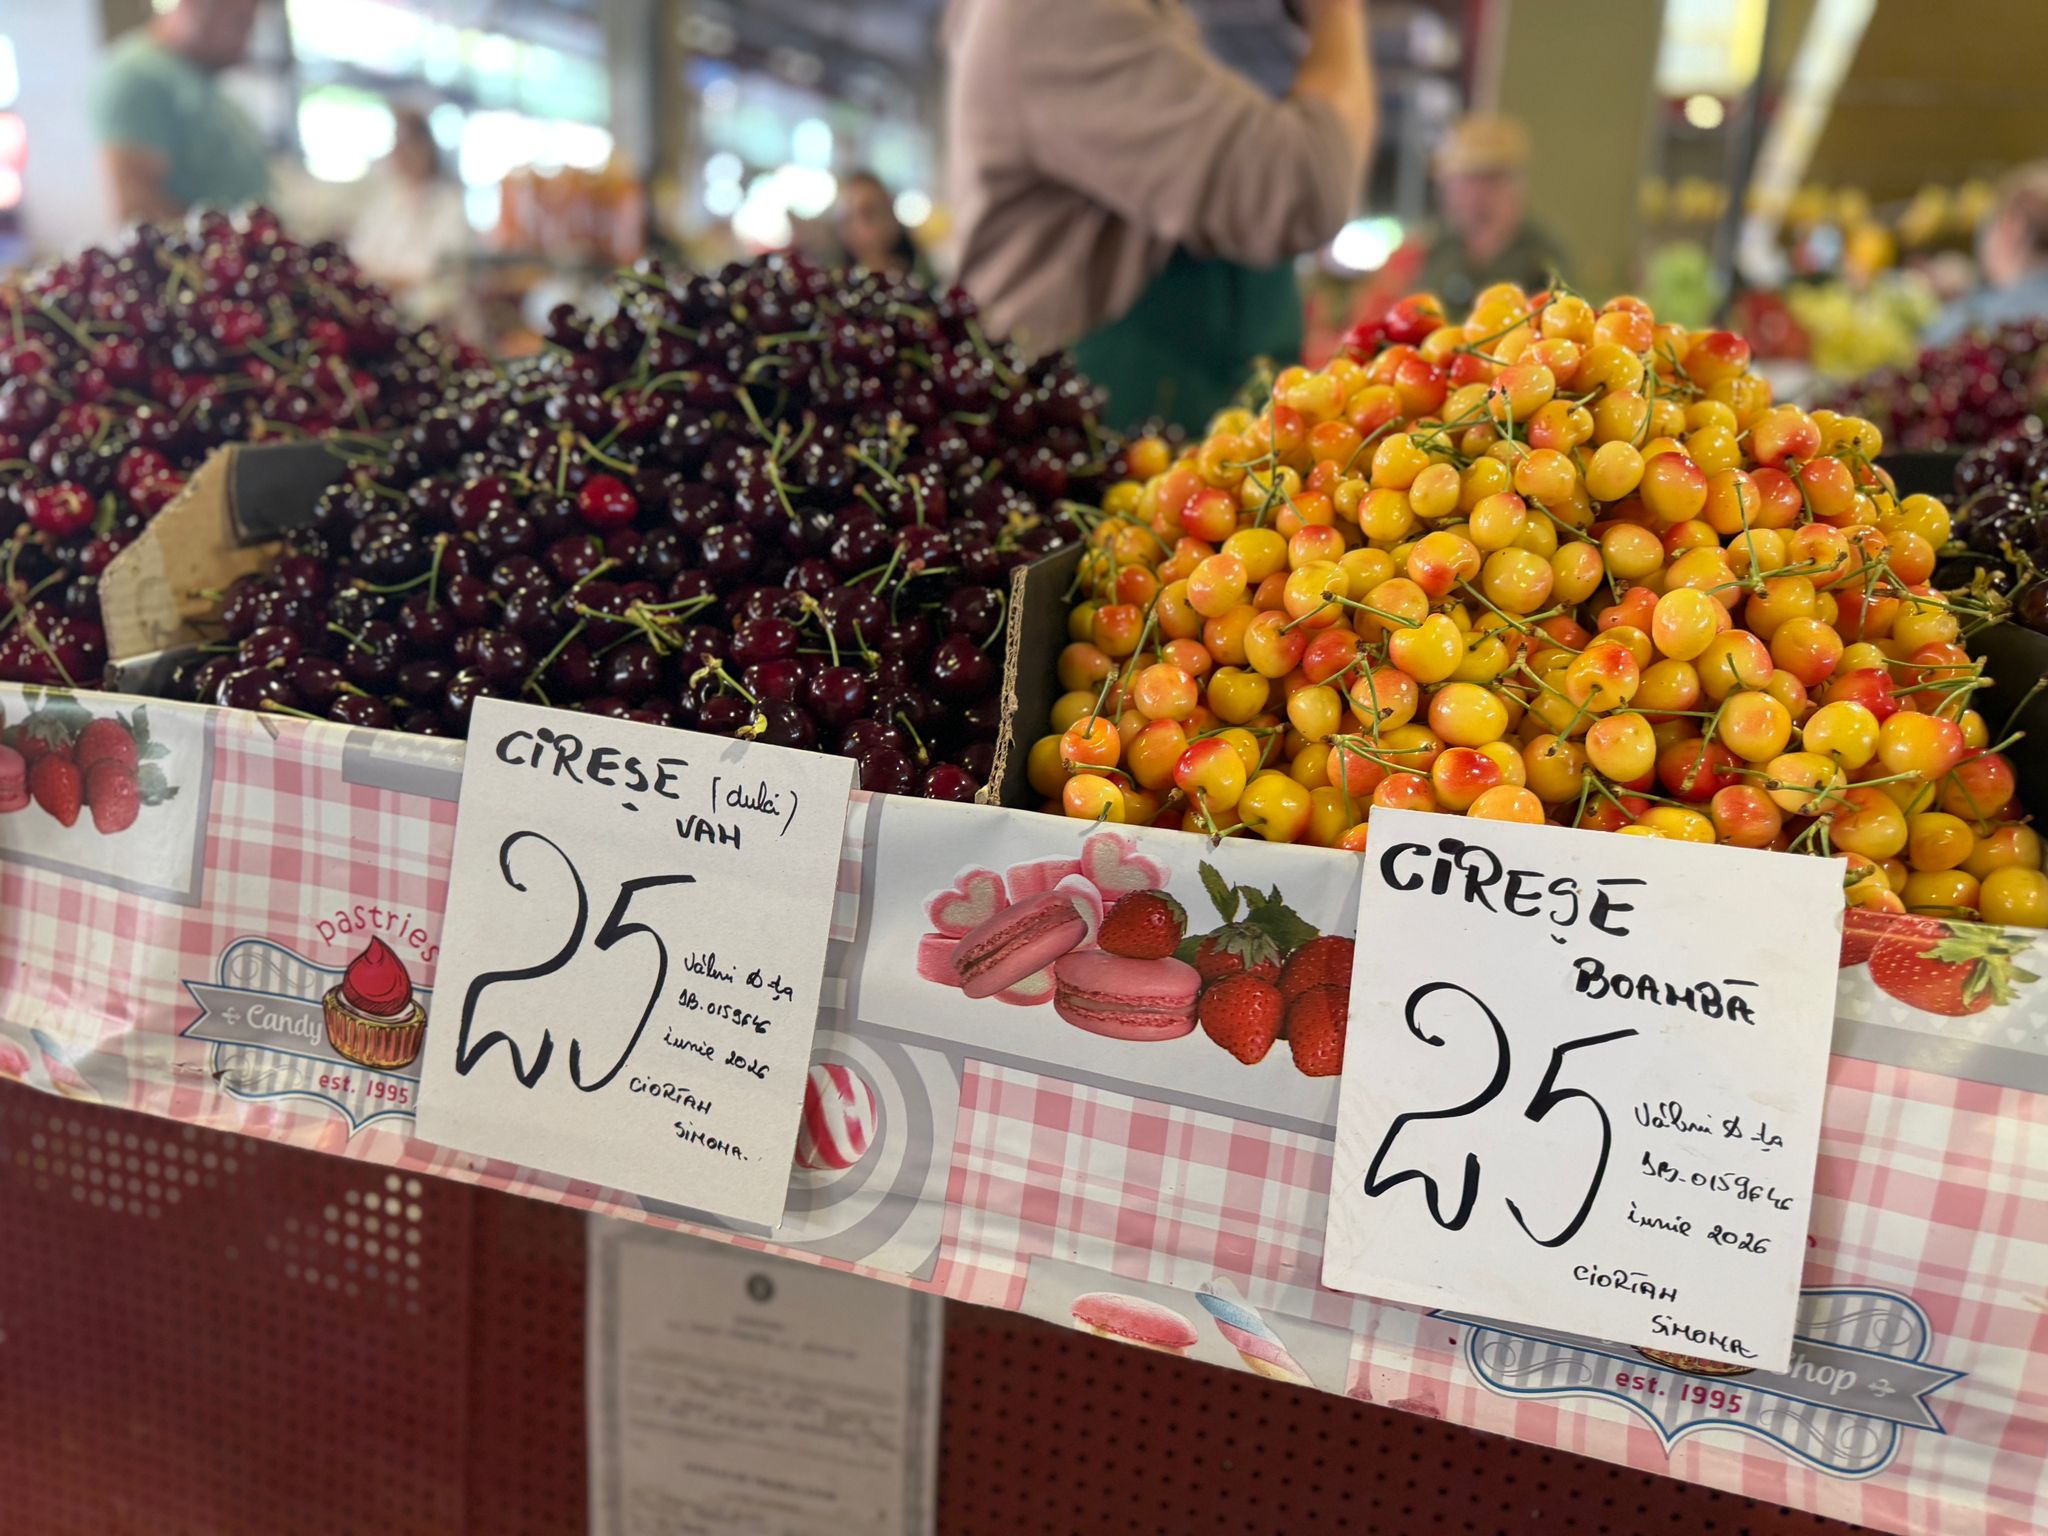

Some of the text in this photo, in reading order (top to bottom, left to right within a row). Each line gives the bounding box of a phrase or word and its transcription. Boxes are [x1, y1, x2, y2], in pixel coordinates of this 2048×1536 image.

[316, 905, 439, 963] pastries
[456, 829, 698, 1094] 25
[247, 1004, 323, 1046] Candy
[664, 1026, 769, 1079] iunie 2026
[319, 1073, 409, 1104] est. 1995
[1364, 979, 1641, 1247] 25
[1628, 1201, 1691, 1236] iunie
[1707, 1225, 1770, 1253] 2026
[1614, 1370, 1744, 1413] est. 1995
[1784, 1352, 1857, 1396] hop
